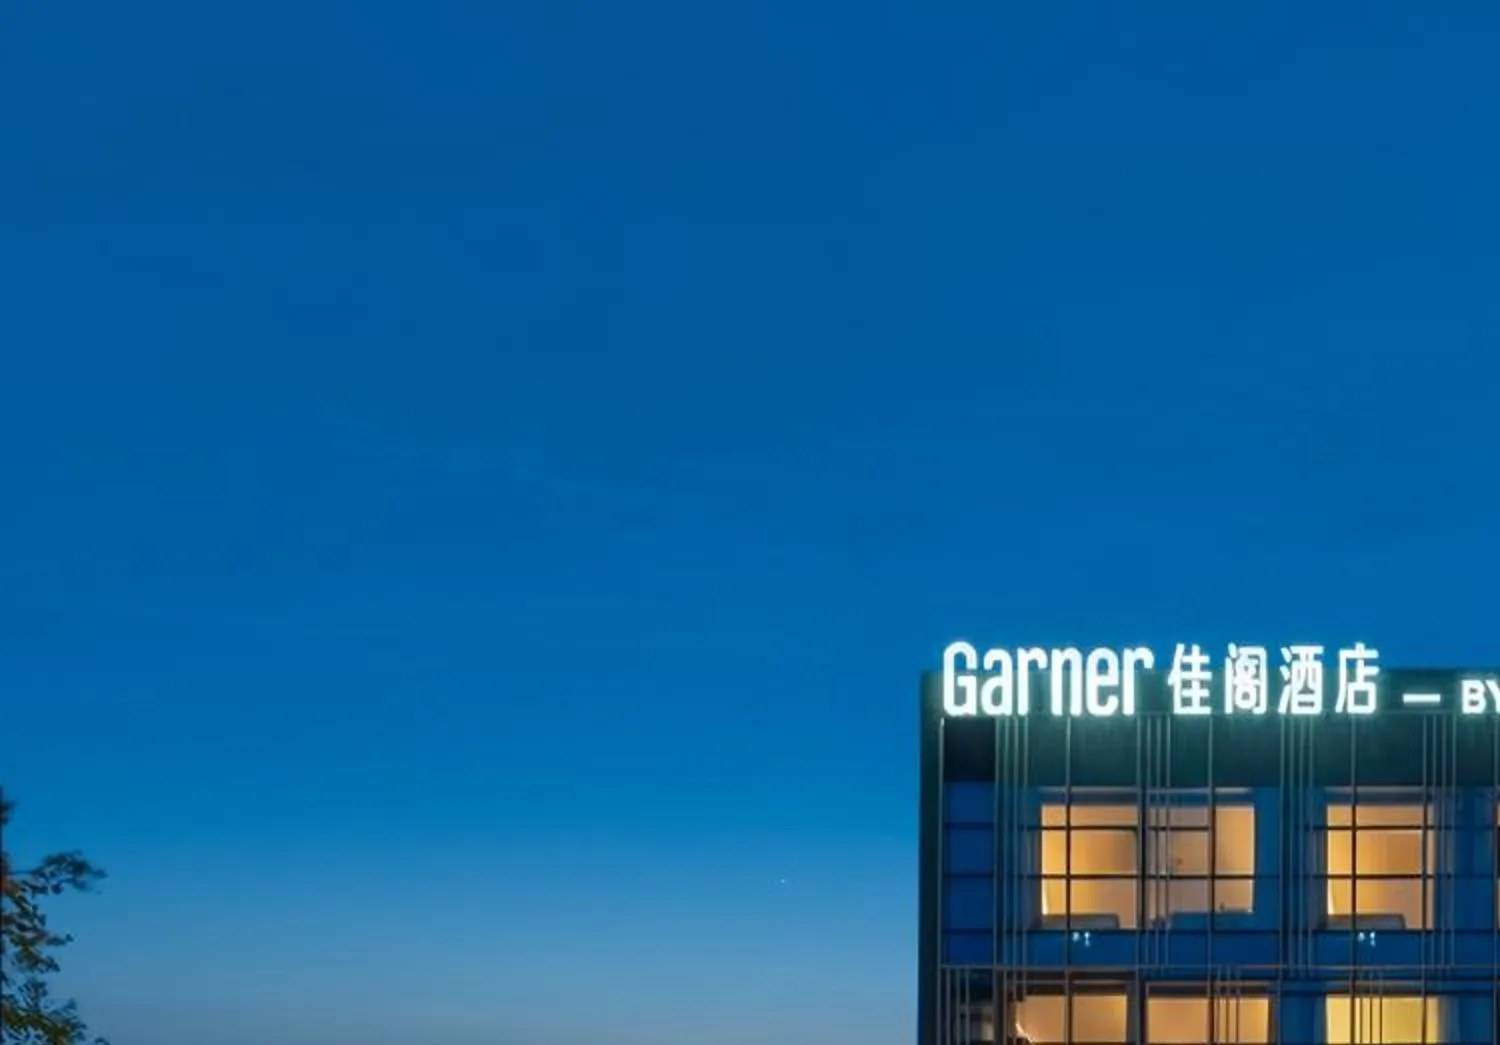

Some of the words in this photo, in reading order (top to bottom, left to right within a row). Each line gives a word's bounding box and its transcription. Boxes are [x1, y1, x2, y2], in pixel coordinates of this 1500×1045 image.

[941, 641, 1155, 717] Garner
[1166, 642, 1380, 716] 佳阁酒店
